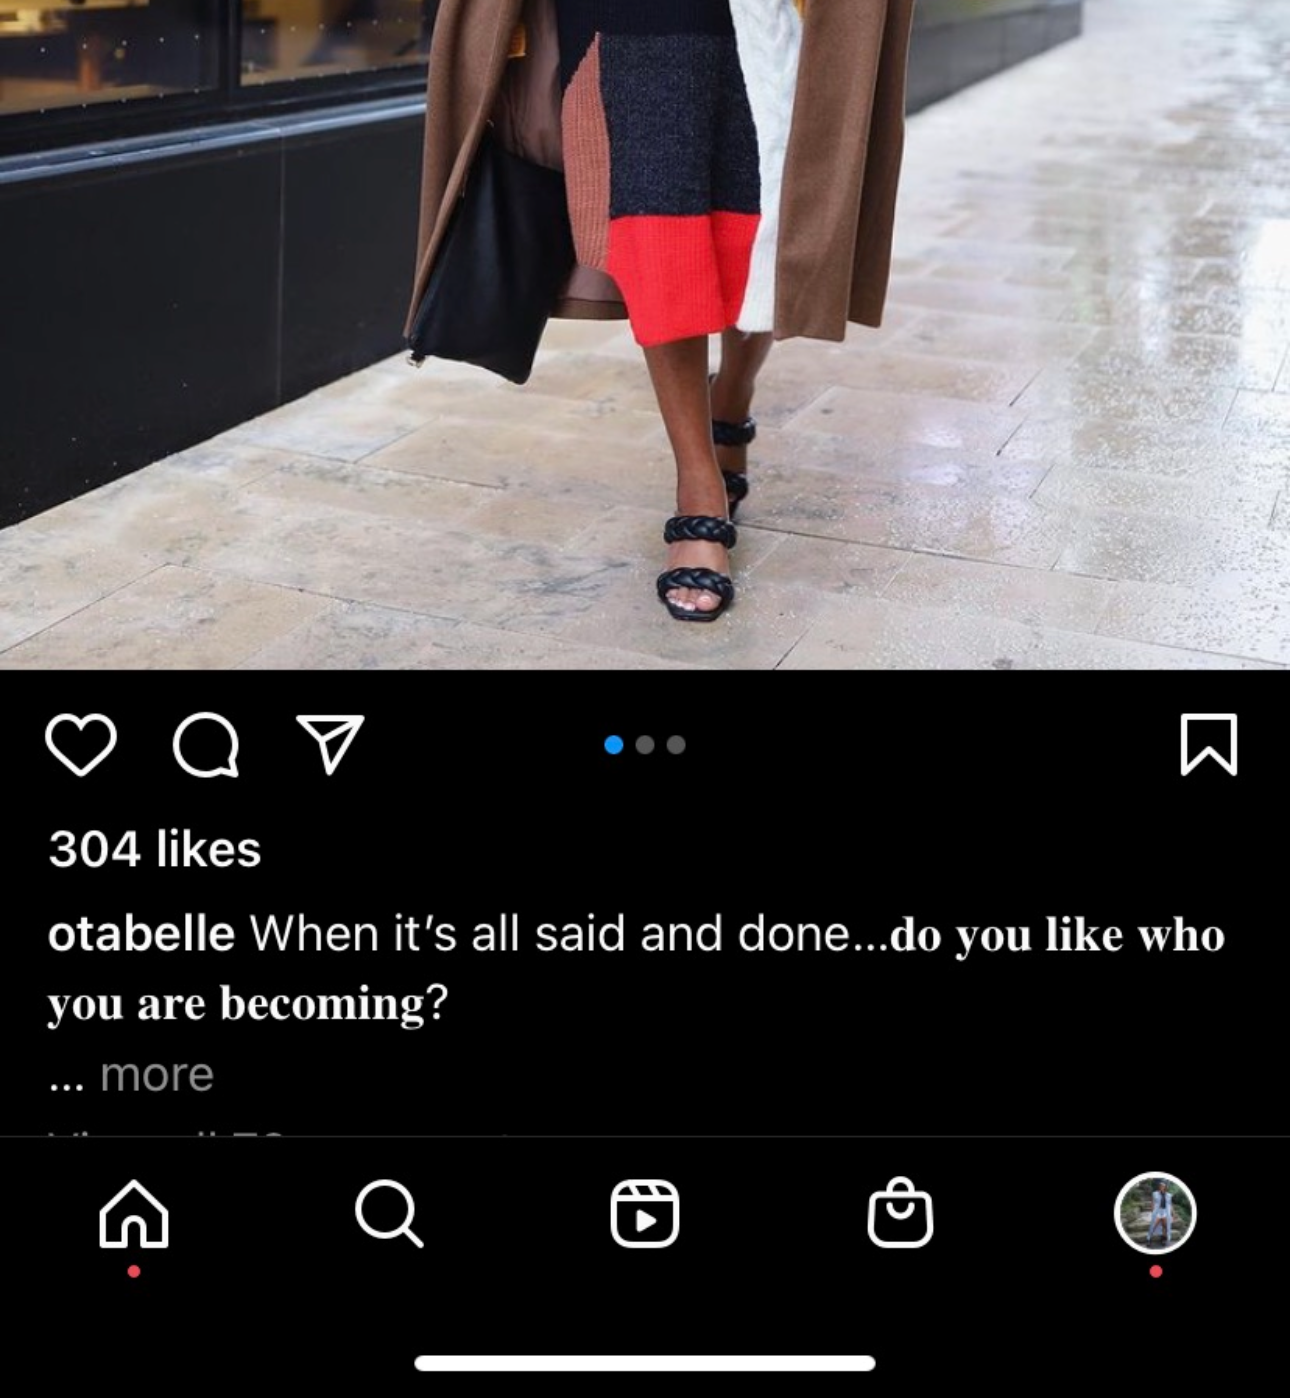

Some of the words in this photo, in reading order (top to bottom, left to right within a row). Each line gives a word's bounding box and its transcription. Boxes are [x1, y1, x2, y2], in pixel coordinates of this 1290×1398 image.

[49, 830, 141, 868] 304
[158, 828, 261, 868] likes
[48, 913, 235, 952] otabelle
[250, 913, 377, 951] When
[472, 913, 518, 952] all
[536, 913, 624, 952] said
[641, 913, 721, 952] and
[955, 927, 1032, 961] you
[1045, 916, 1123, 952] like
[1137, 916, 1225, 952] who
[47, 995, 123, 1029] you
[138, 995, 206, 1021] are
[219, 983, 448, 1029] becoming?
[103, 1064, 213, 1092] more
